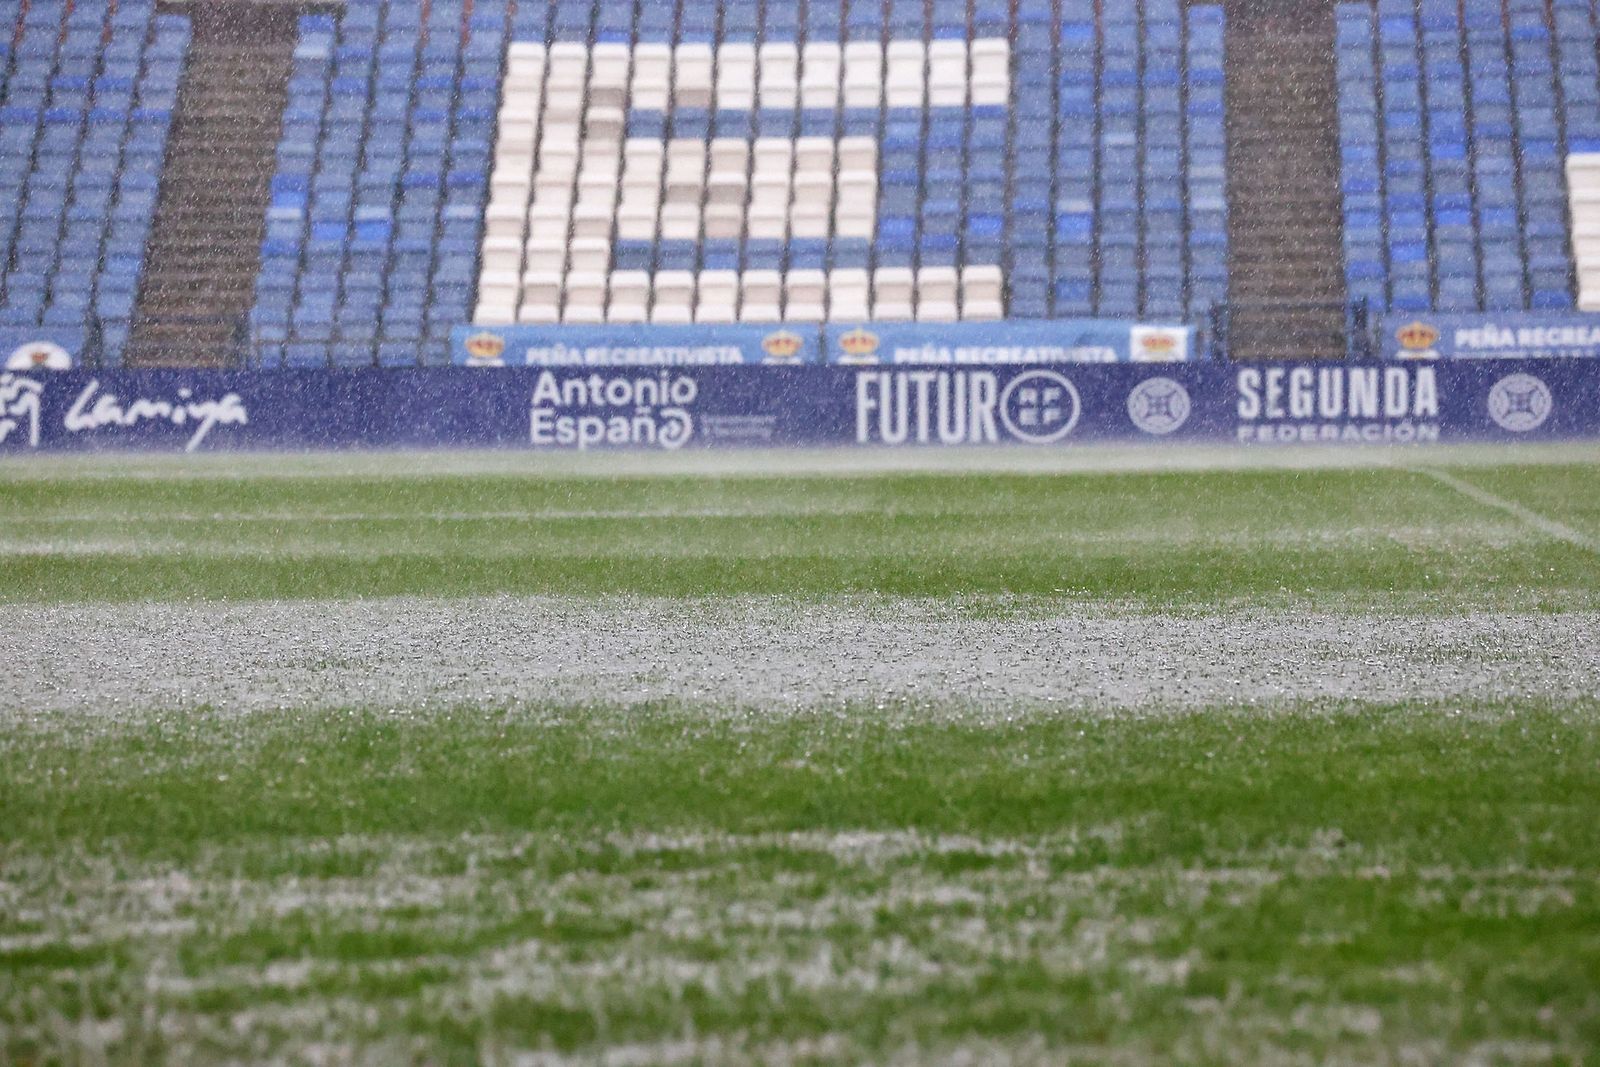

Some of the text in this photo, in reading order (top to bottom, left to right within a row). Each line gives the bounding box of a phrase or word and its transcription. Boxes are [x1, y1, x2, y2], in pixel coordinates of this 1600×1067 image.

[531, 370, 698, 406] Antonio
[1237, 366, 1439, 419] SEGUNDA
[1237, 419, 1439, 443] FEDERACIÓN
